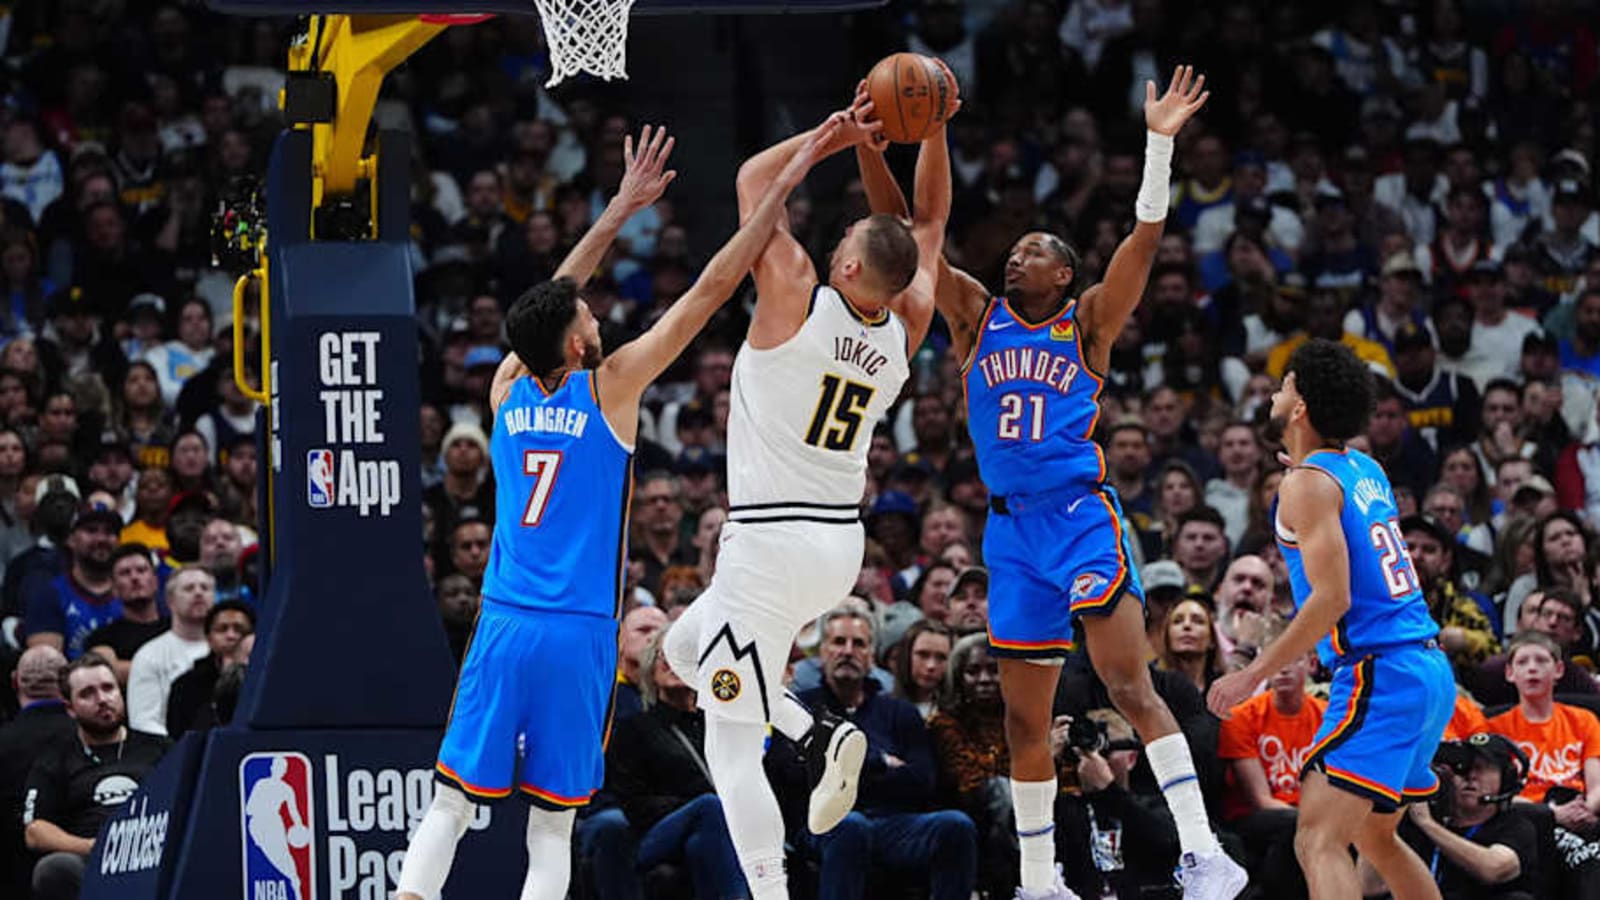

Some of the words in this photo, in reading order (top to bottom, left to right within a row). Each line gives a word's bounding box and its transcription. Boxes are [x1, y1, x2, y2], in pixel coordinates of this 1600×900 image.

[319, 332, 380, 386] GET
[979, 347, 1080, 396] THUNDER
[319, 389, 384, 443] THE
[504, 405, 589, 438] HOLMGREN
[804, 371, 878, 453] 15
[998, 392, 1045, 441] 21
[337, 449, 400, 516] App
[520, 449, 563, 527] 7
[325, 754, 491, 842] Leag
[101, 795, 169, 875] coinbase
